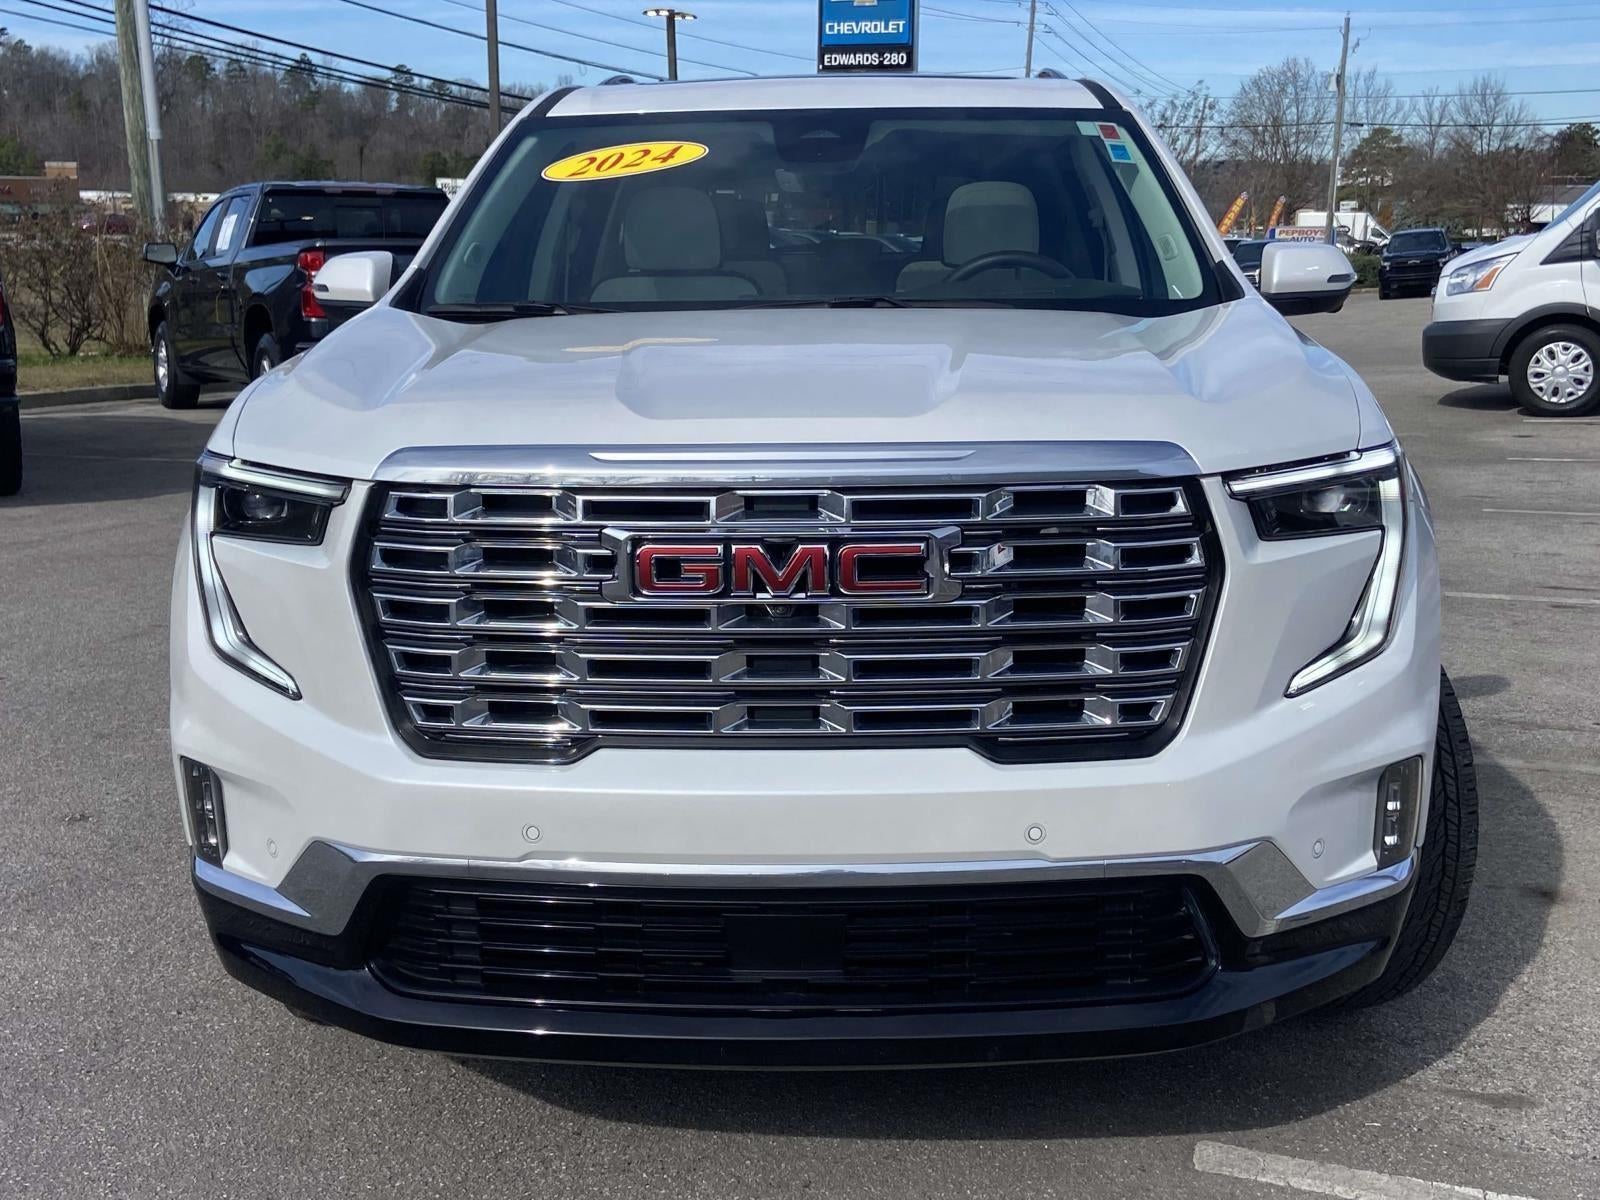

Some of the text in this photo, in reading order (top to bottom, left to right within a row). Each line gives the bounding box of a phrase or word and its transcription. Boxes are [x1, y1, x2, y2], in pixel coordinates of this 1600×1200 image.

[825, 20, 906, 35] CHEVROLET
[823, 52, 907, 66] EDWARDS-280
[565, 144, 684, 178] 2024
[635, 543, 929, 596] GMC
